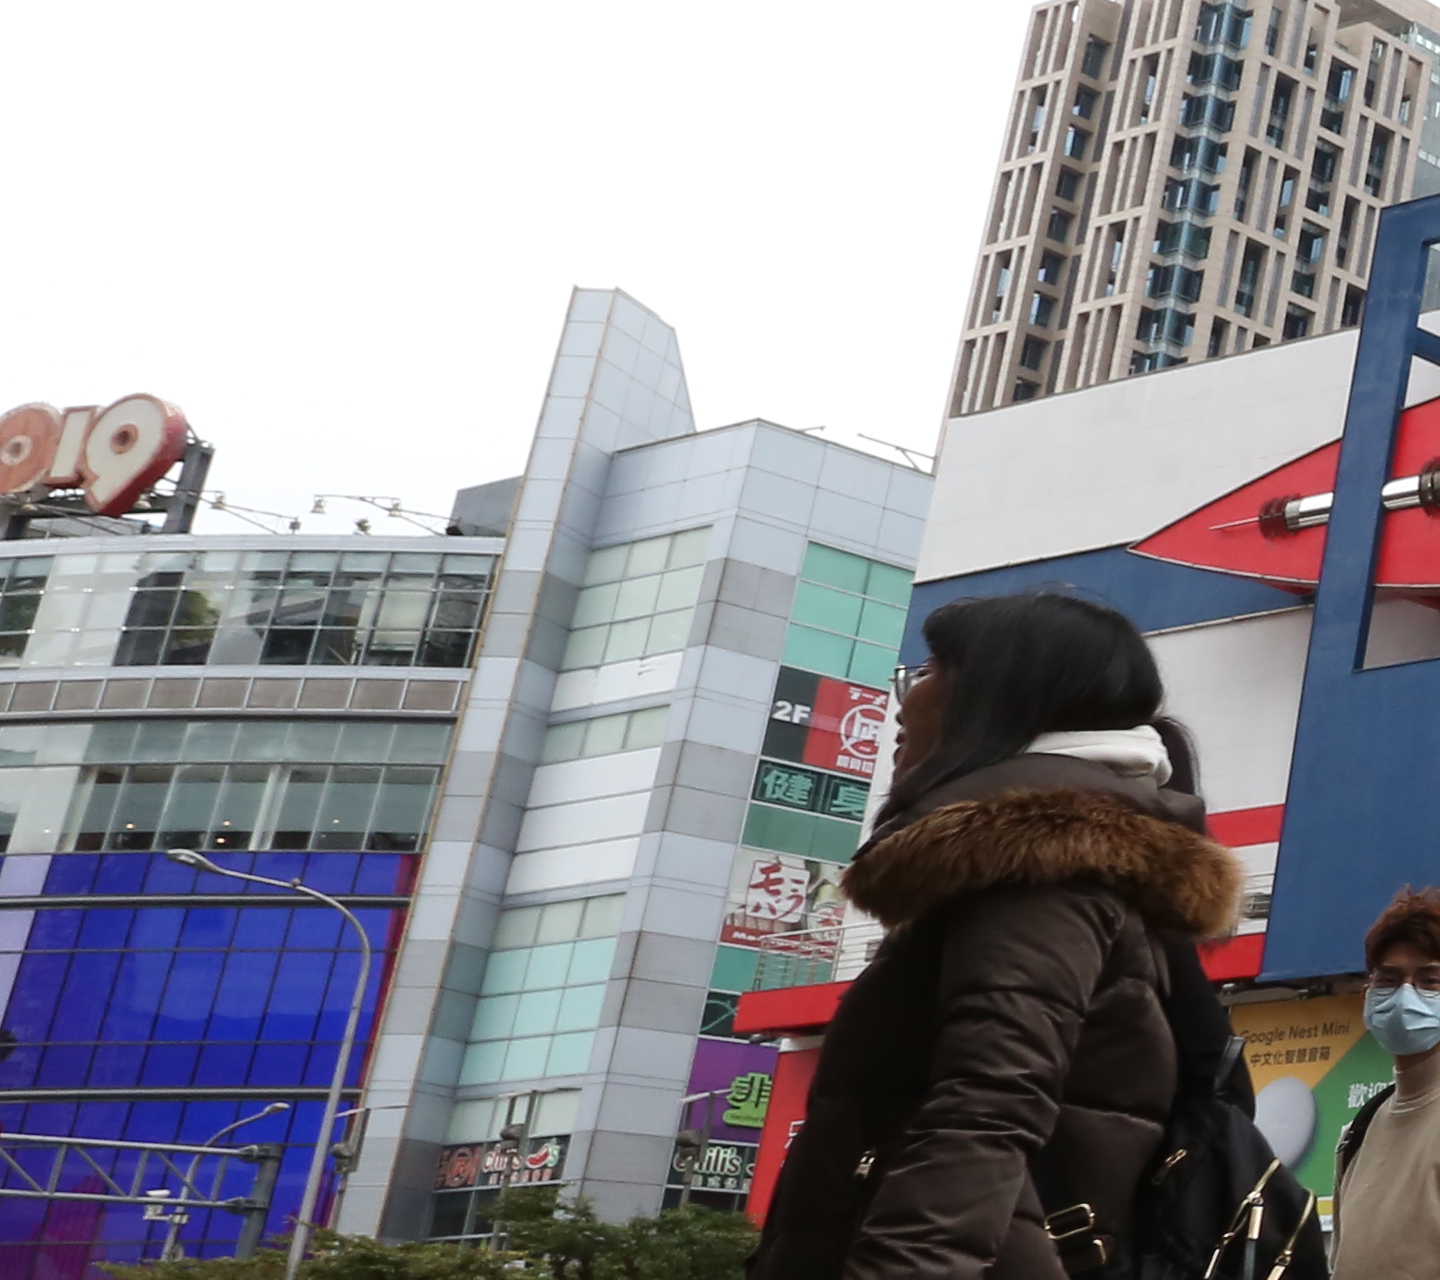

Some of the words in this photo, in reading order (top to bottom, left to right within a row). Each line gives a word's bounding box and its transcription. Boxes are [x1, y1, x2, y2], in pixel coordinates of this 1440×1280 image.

[771, 700, 812, 725] 2F
[763, 769, 868, 818] 健身
[1240, 1027, 1286, 1047] Google
[1287, 1023, 1322, 1040] Nest
[1323, 1020, 1351, 1037] Mini
[1249, 1046, 1332, 1068] 中文化智慧音箱
[1347, 1081, 1396, 1109] 歡迎
